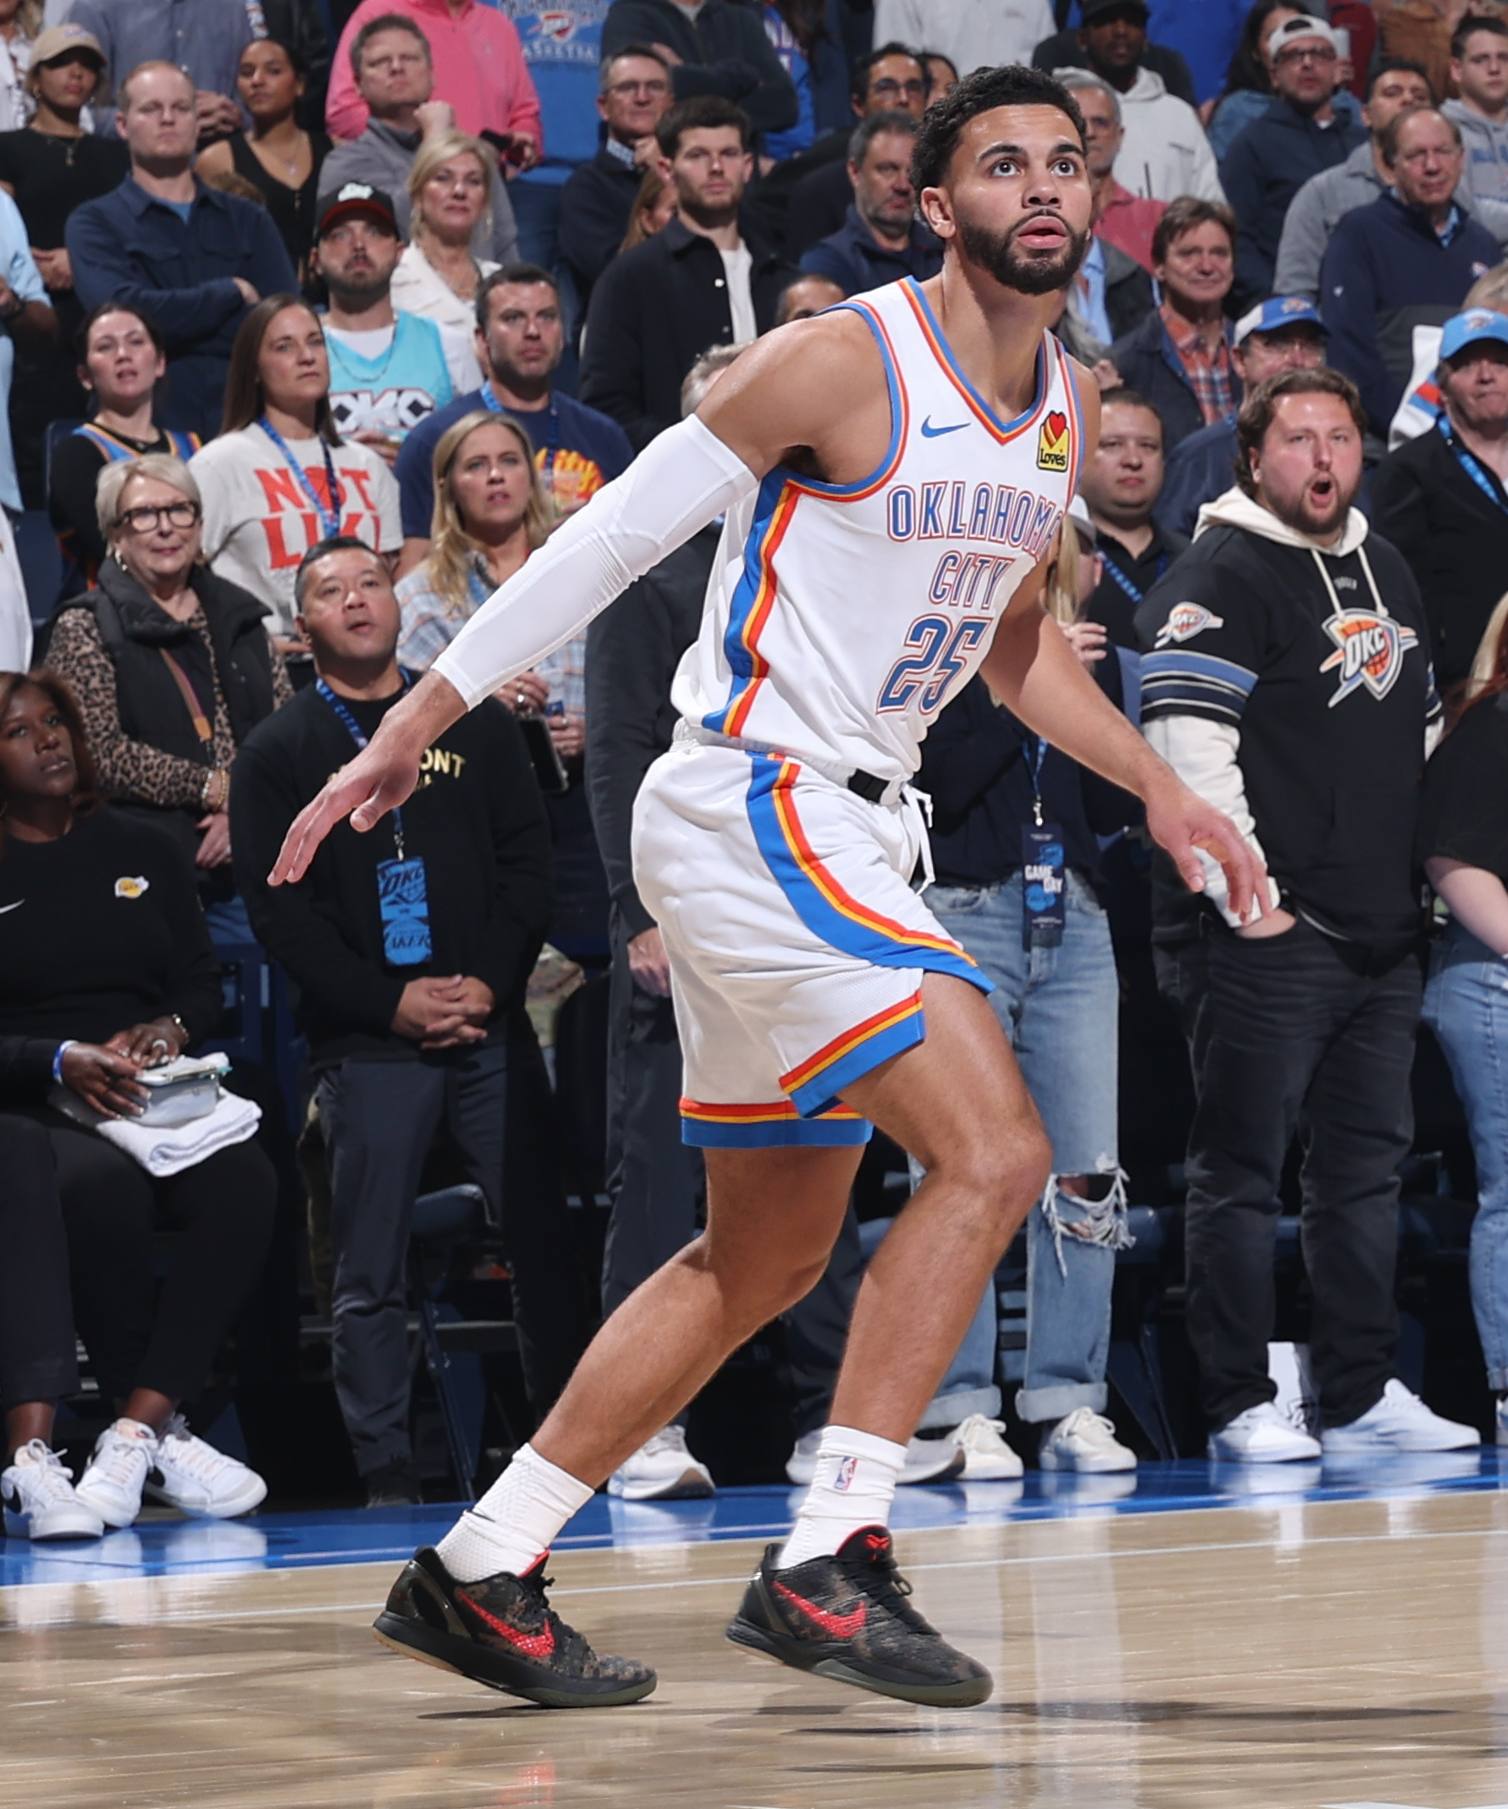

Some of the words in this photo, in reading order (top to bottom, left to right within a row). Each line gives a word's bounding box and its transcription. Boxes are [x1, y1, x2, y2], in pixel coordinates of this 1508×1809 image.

[255, 467, 371, 513] NOT
[262, 512, 382, 571] LIK
[928, 550, 1014, 610] CITY
[876, 613, 993, 715] 25
[1344, 626, 1386, 680] OKC
[1025, 865, 1055, 882] GAME
[1043, 877, 1063, 894] DAY
